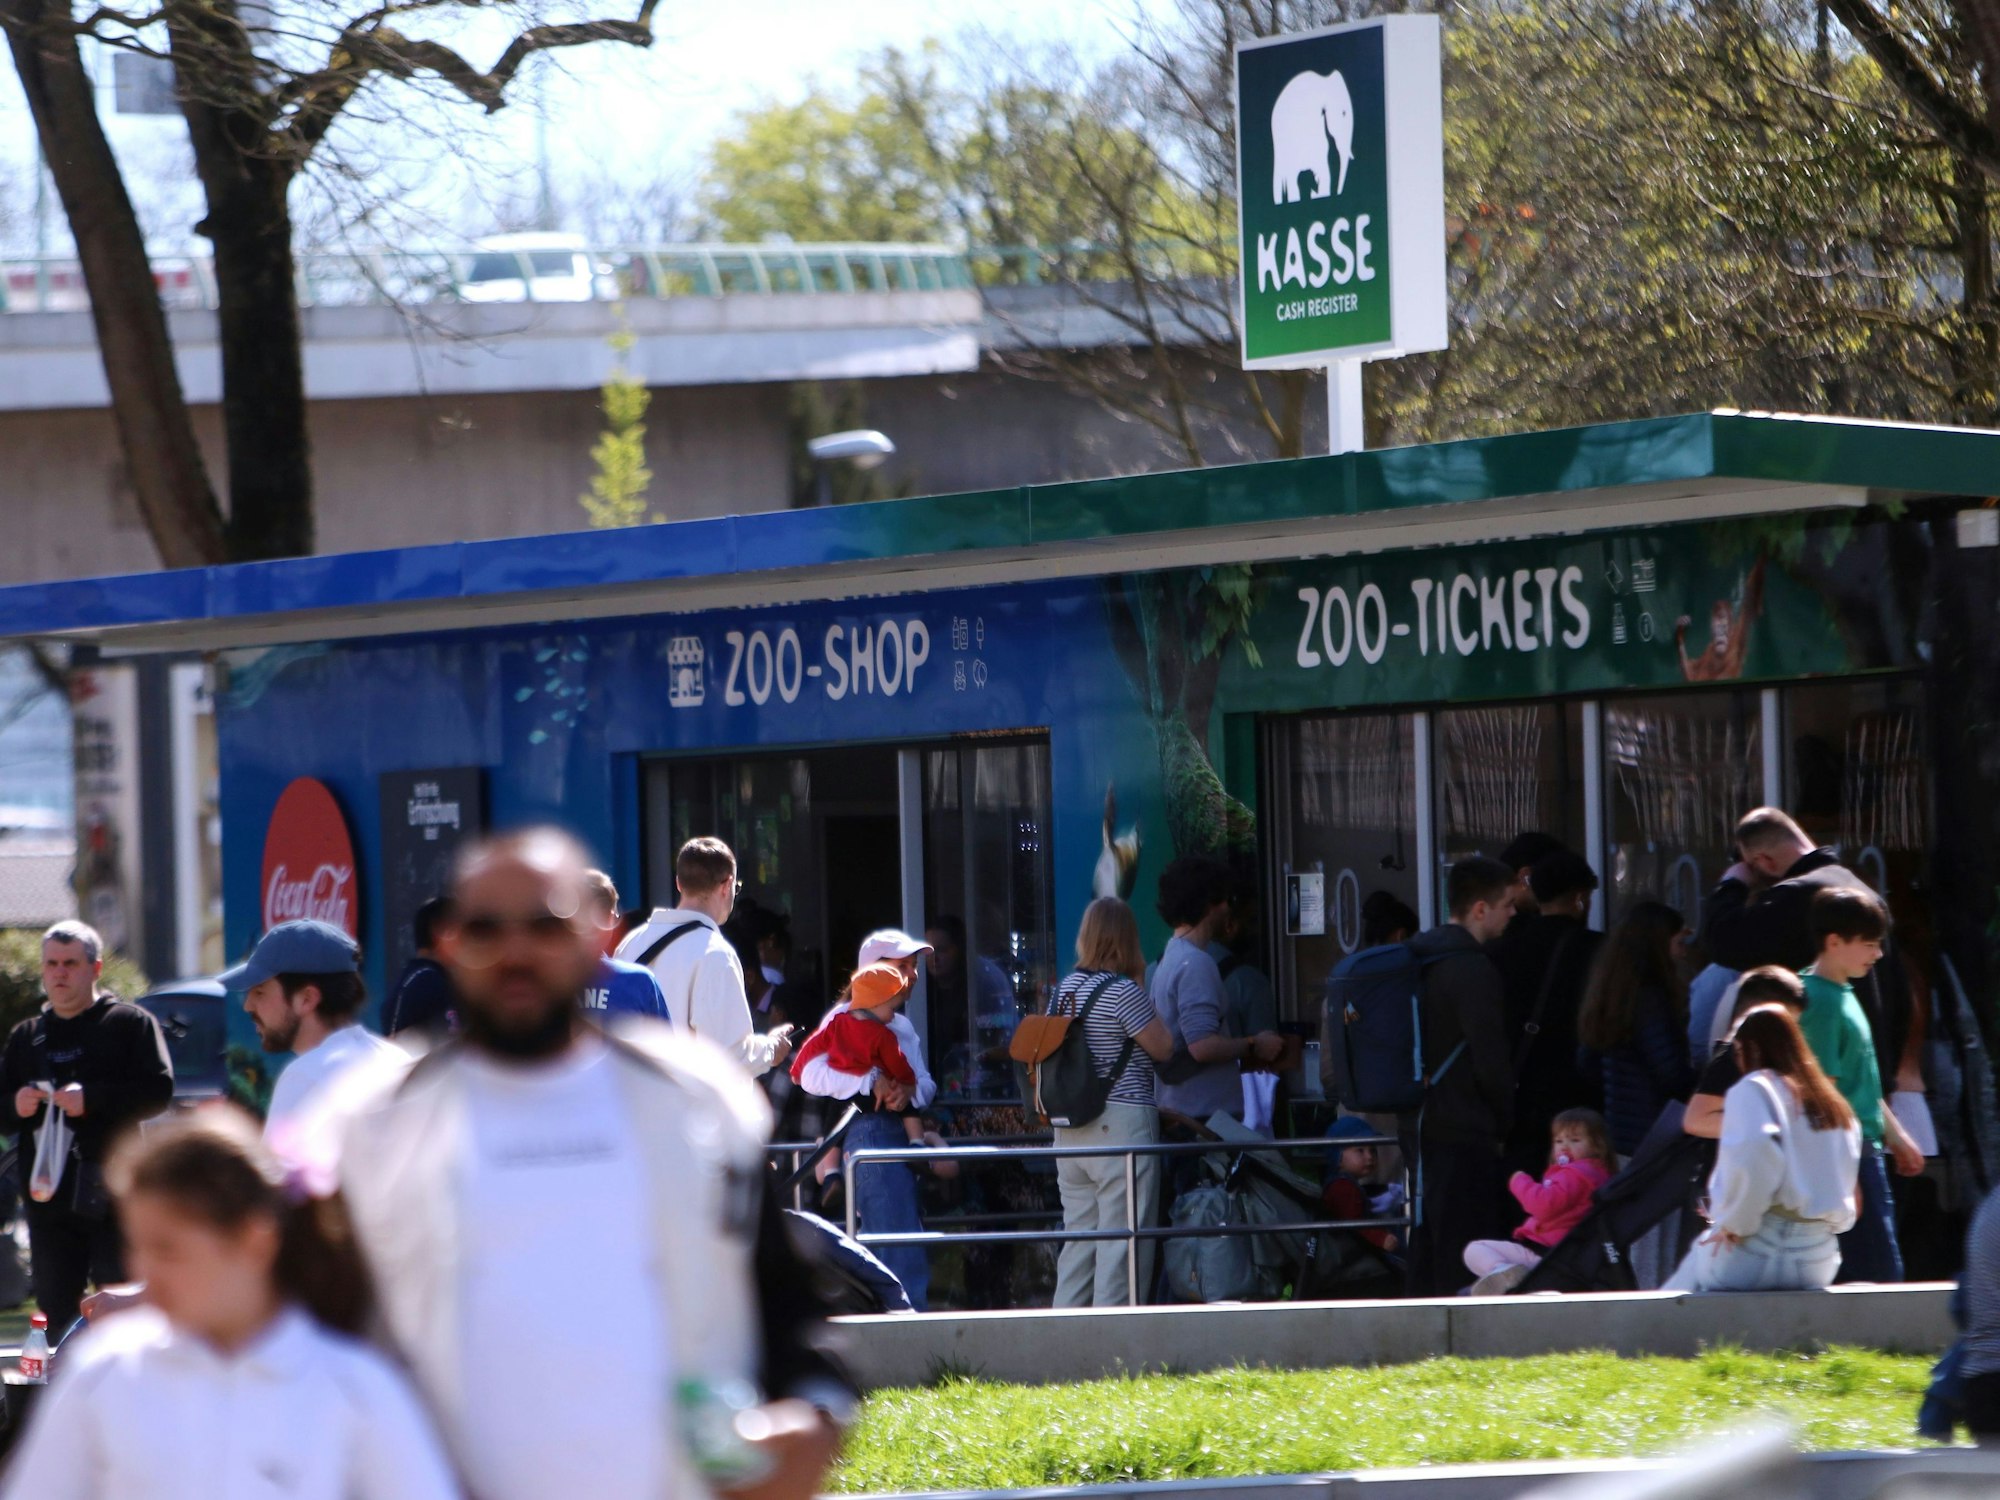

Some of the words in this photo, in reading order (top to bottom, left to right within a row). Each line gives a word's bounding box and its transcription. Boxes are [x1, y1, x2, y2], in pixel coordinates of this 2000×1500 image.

[1257, 213, 1376, 294] KASSE
[1276, 301, 1306, 322] CASH
[1307, 293, 1359, 317] REGISTER
[1296, 565, 1591, 669] ZOO-TICKETS
[725, 619, 931, 707] ZOO-SHOP
